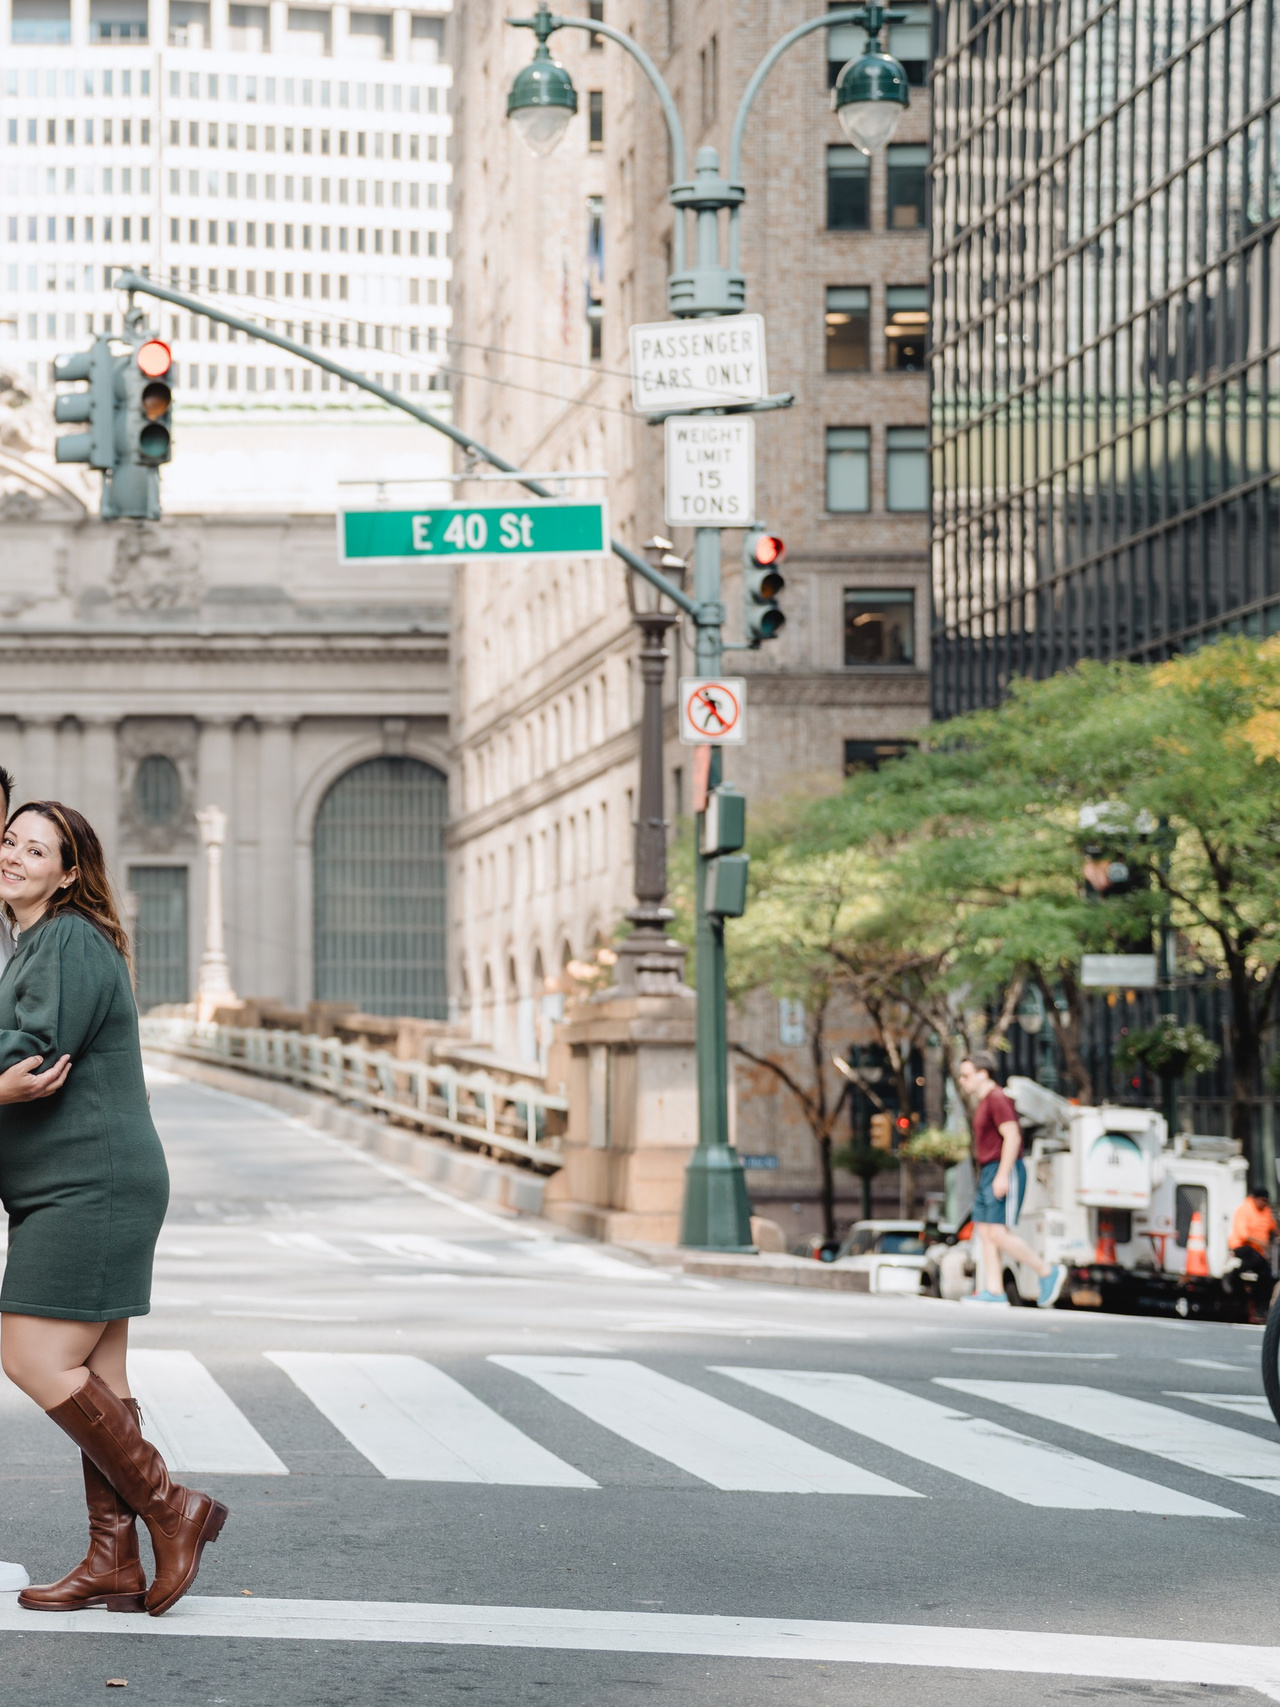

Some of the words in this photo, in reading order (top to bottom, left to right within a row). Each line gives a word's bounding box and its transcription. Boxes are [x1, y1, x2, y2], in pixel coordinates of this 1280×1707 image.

[641, 330, 752, 360] PASSENGER
[643, 367, 692, 392] CARS
[706, 361, 753, 386] ONLY
[676, 427, 742, 443] WEIGHT
[686, 448, 731, 464] LIMIT
[698, 470, 721, 489] 15
[680, 495, 738, 514] TONS
[411, 515, 433, 550] E
[443, 513, 488, 549] 40
[499, 512, 534, 548] St
